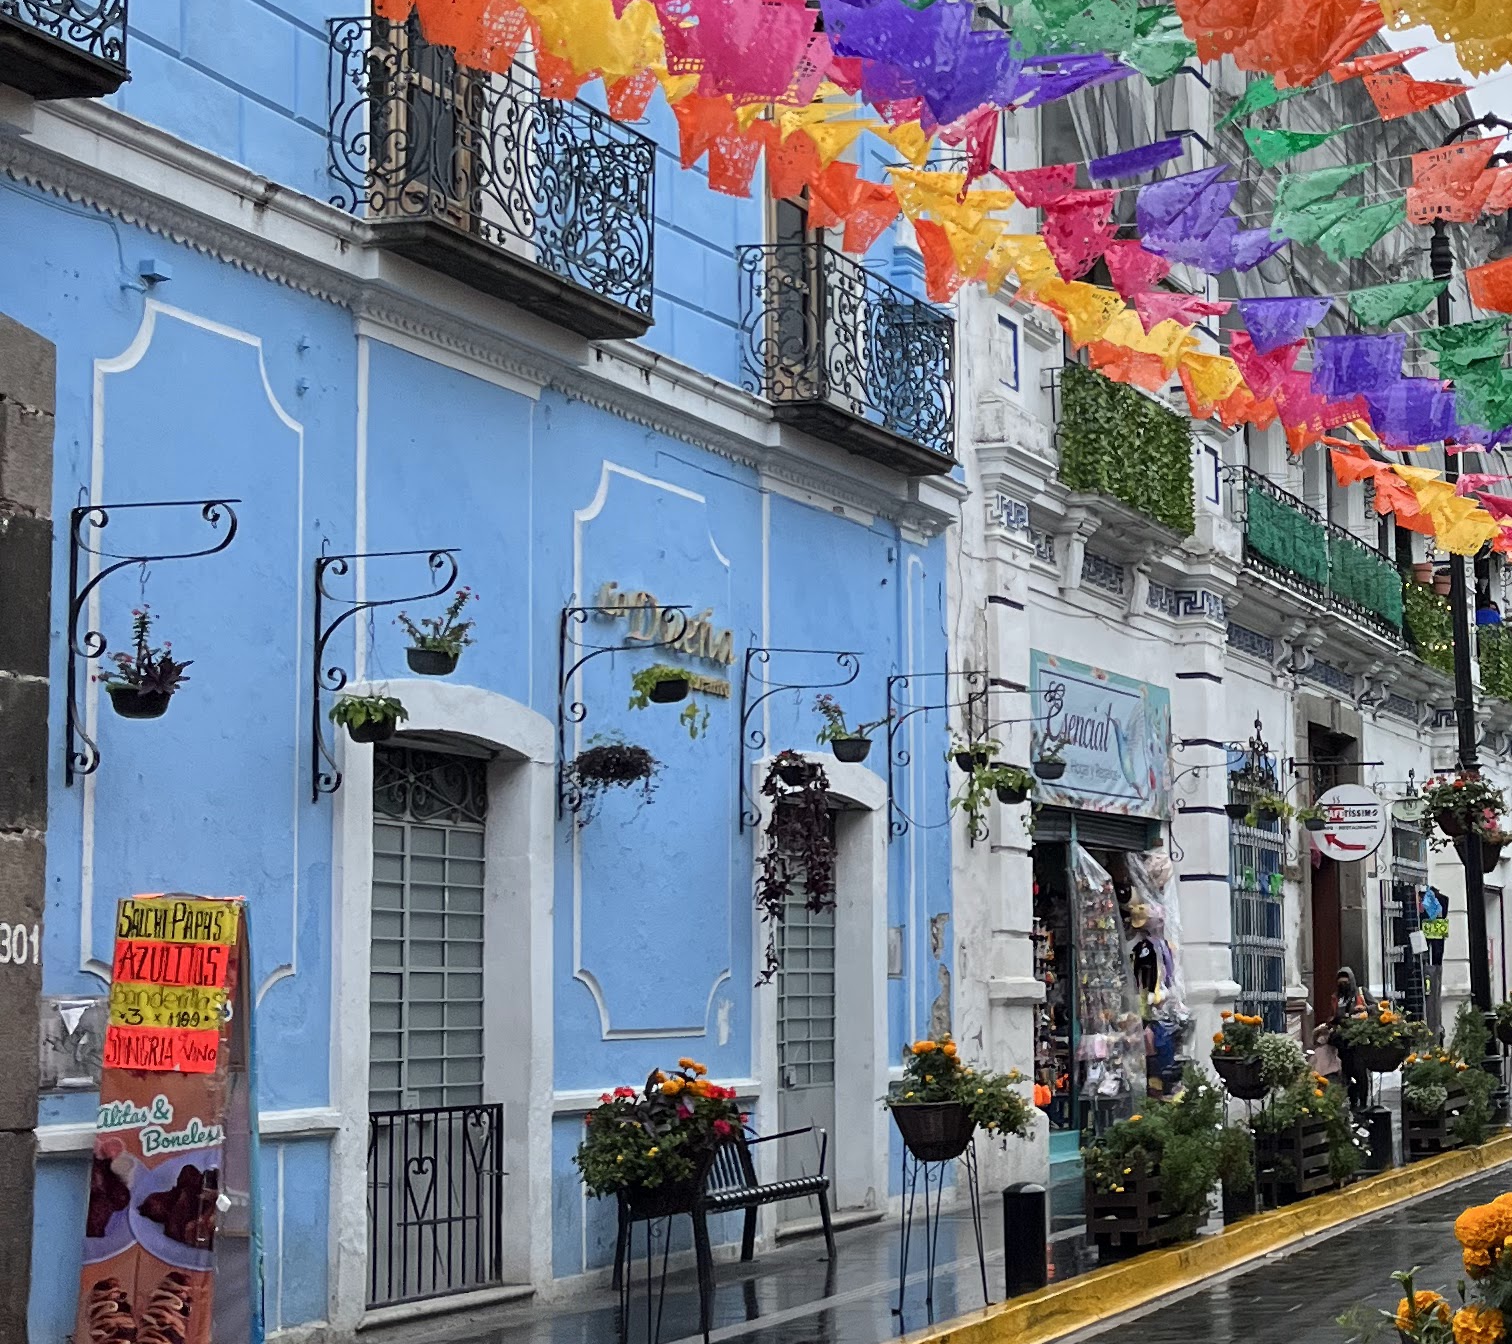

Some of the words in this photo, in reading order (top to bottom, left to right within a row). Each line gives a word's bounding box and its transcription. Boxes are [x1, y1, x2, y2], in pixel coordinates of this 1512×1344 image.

[0, 922, 39, 965] 301
[117, 942, 221, 987] AZULITOS
[154, 1099, 169, 1119] &
